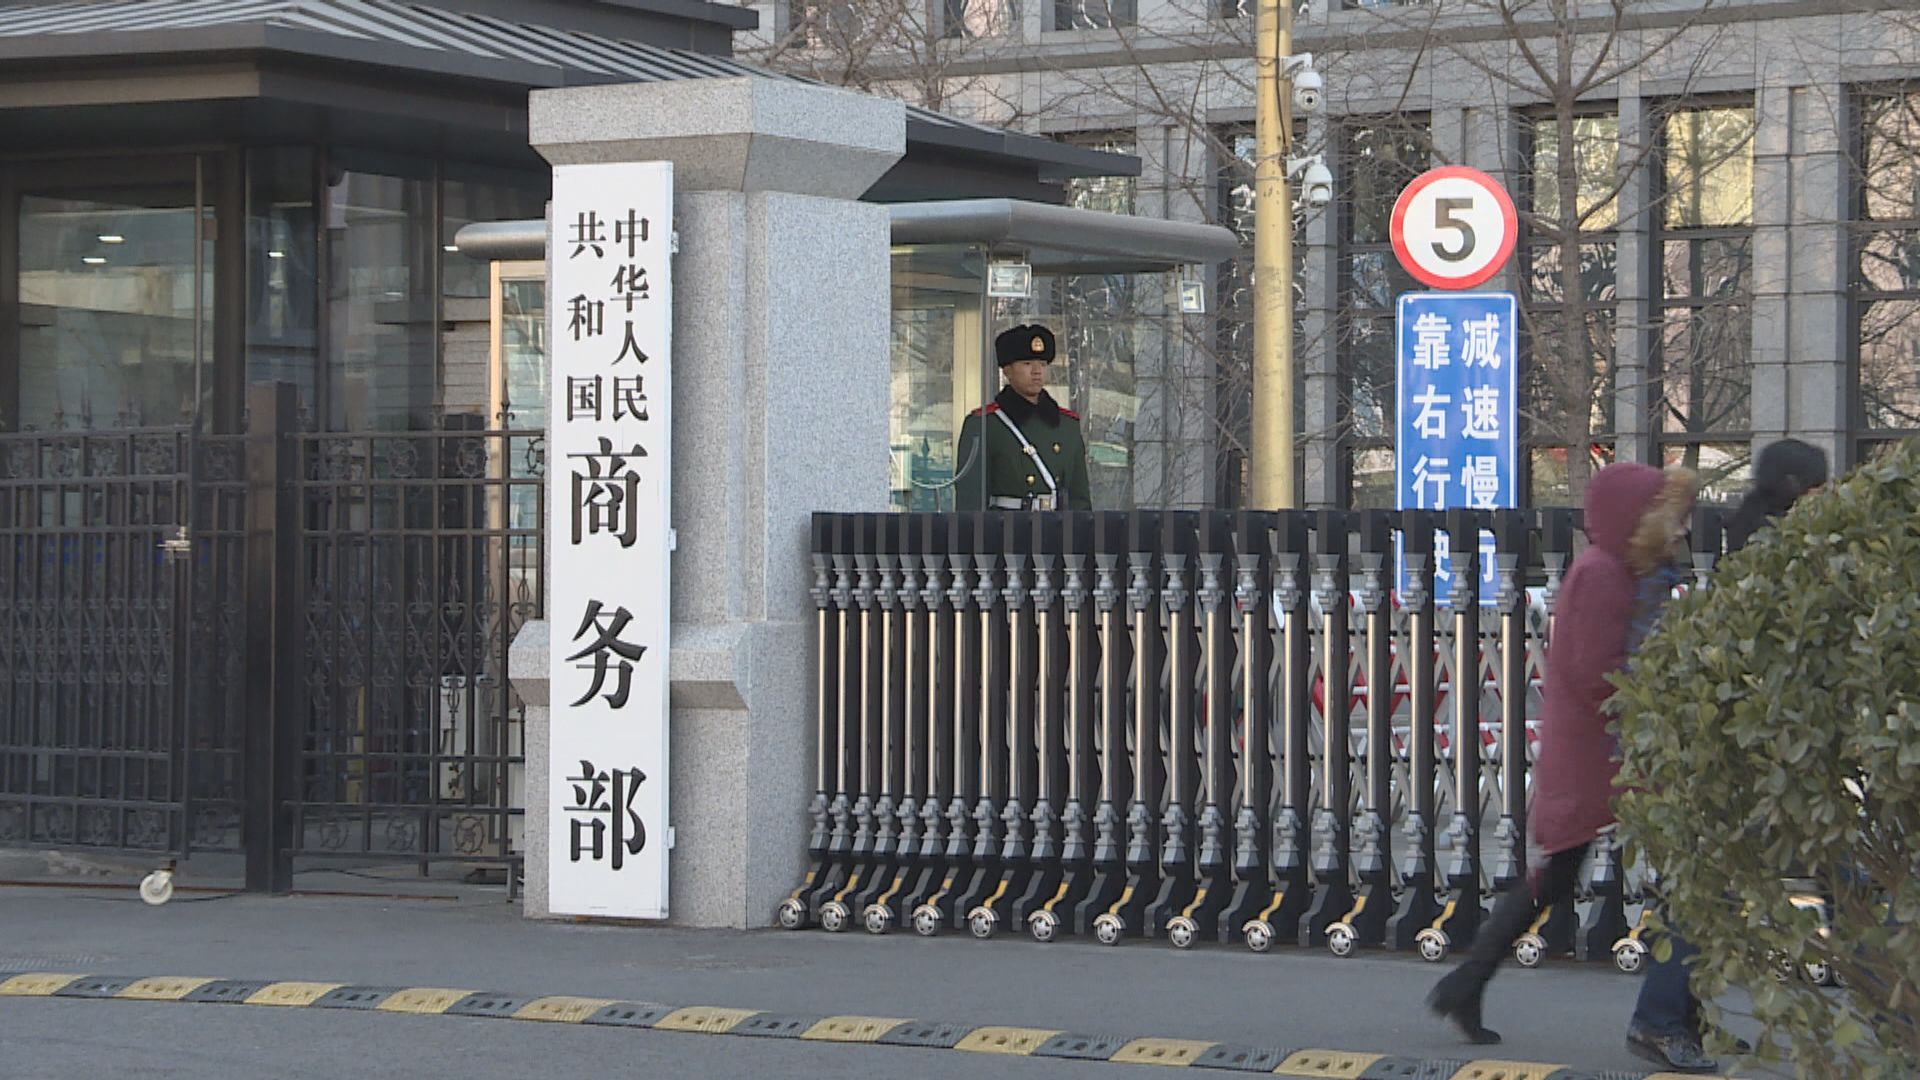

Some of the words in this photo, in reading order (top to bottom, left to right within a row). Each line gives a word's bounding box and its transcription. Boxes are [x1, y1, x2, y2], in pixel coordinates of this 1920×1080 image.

[566, 211, 606, 422] 共和国
[610, 208, 650, 422] 中华人民
[1431, 197, 1476, 263] 5
[563, 436, 648, 871] 商务部
